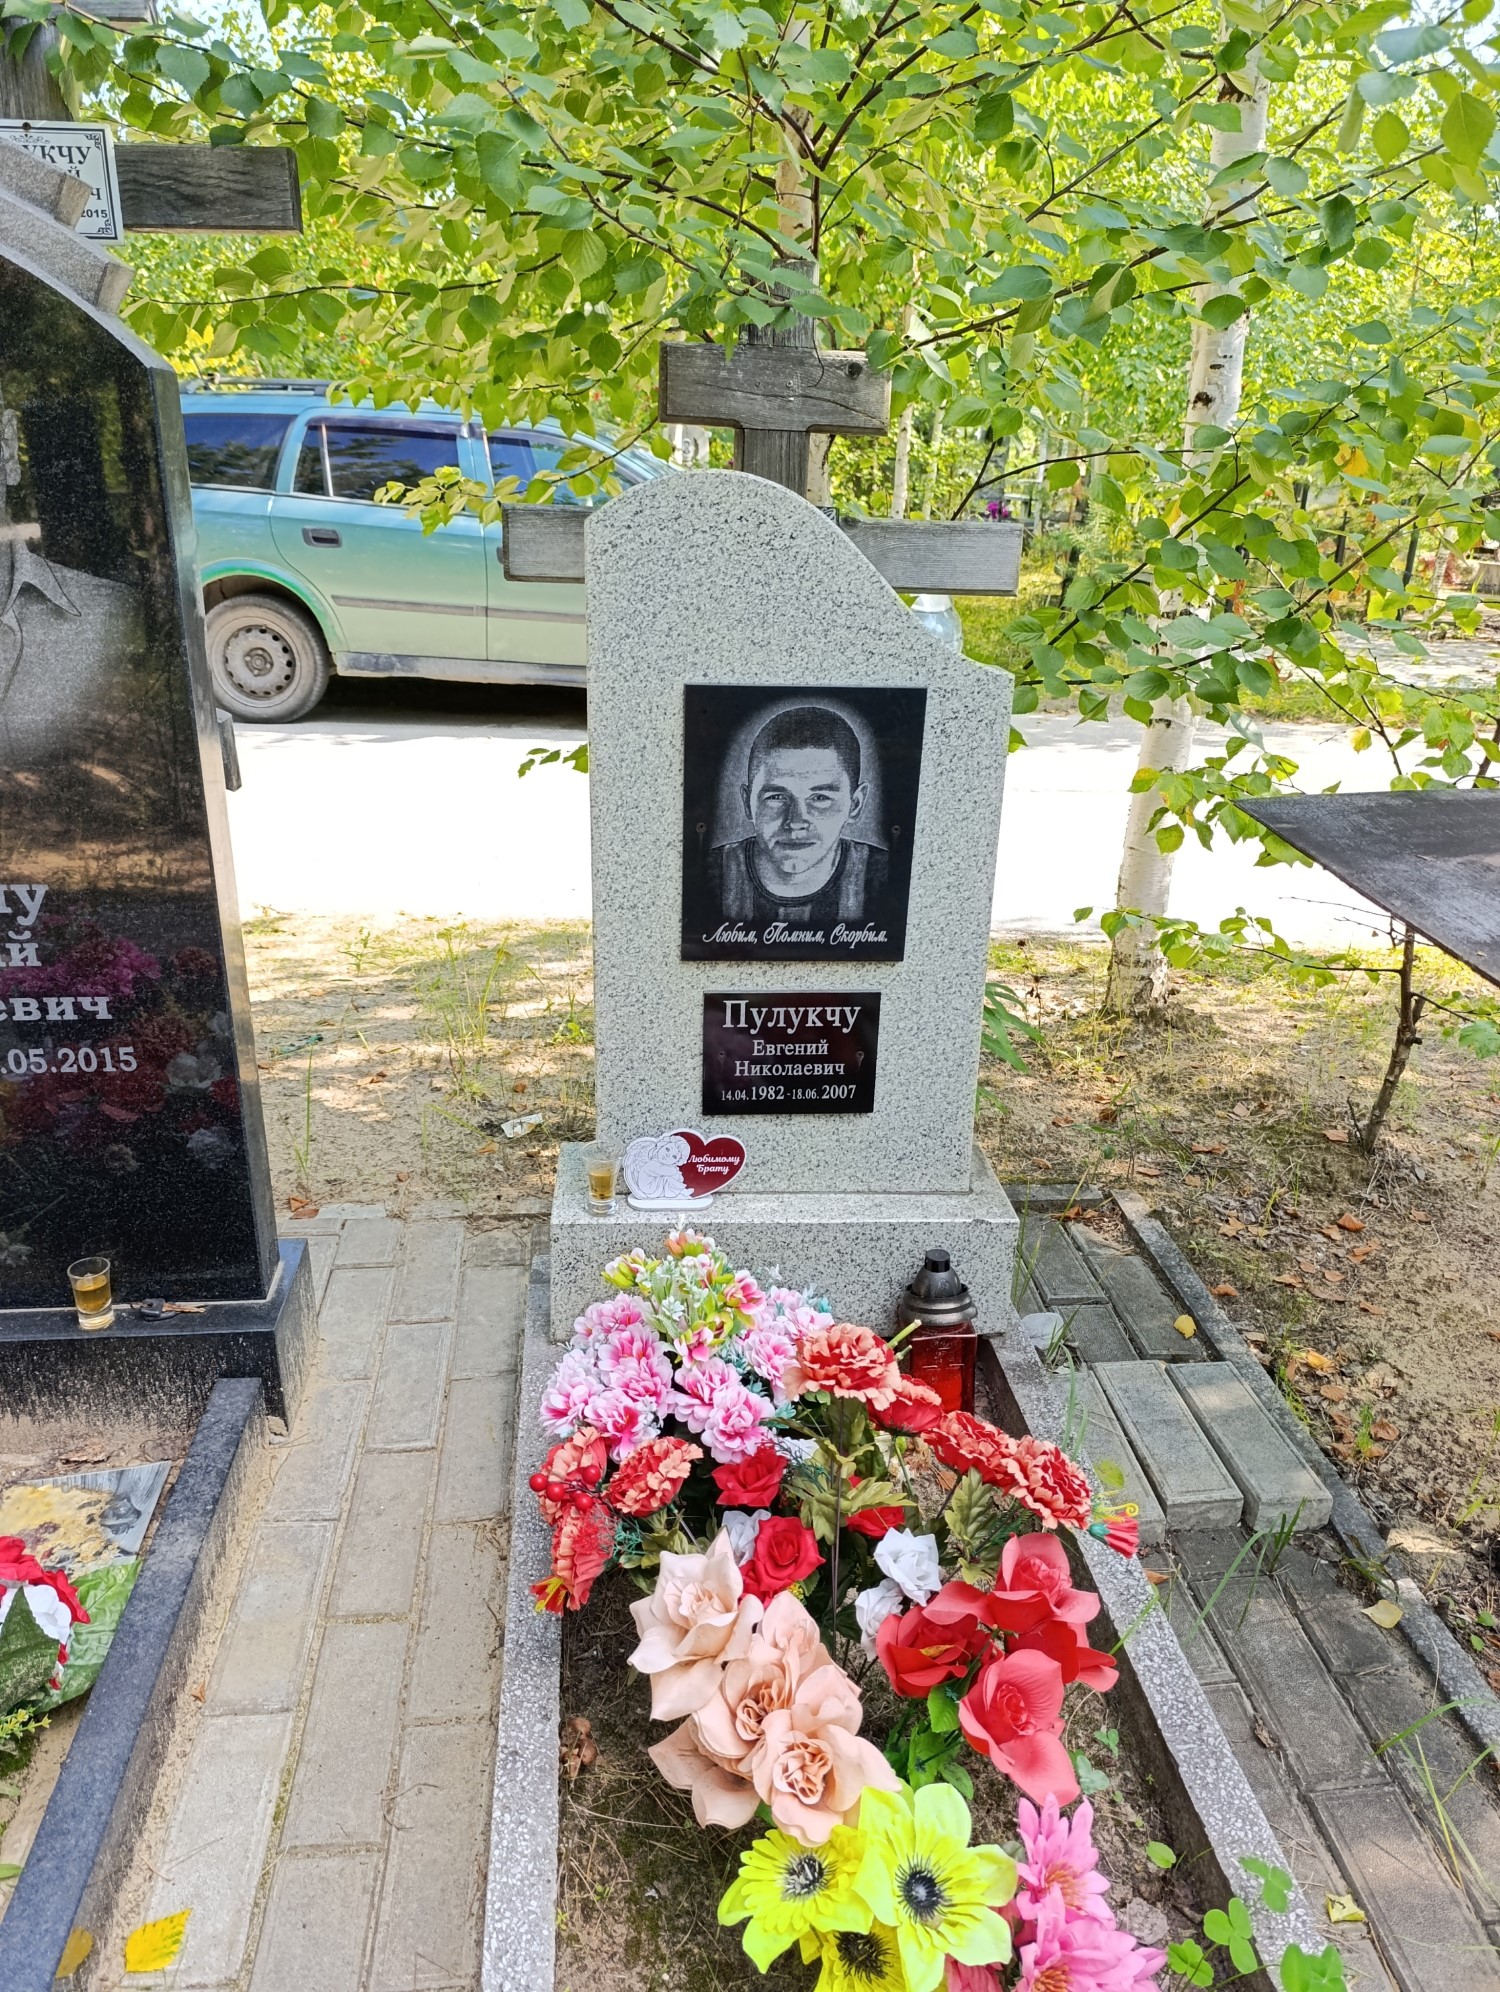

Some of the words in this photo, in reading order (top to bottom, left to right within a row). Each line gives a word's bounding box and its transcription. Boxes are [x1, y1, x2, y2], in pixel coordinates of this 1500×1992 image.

[702, 922, 758, 944] Любим,
[763, 921, 825, 944] Помним,
[829, 922, 888, 949] Скорбим.
[722, 1000, 862, 1035] Пулукчу
[752, 1039, 829, 1056] Евгений
[734, 1060, 845, 1077] Николаевич
[688, 1153, 740, 1166] Любимому
[696, 1164, 730, 1176] Брату
